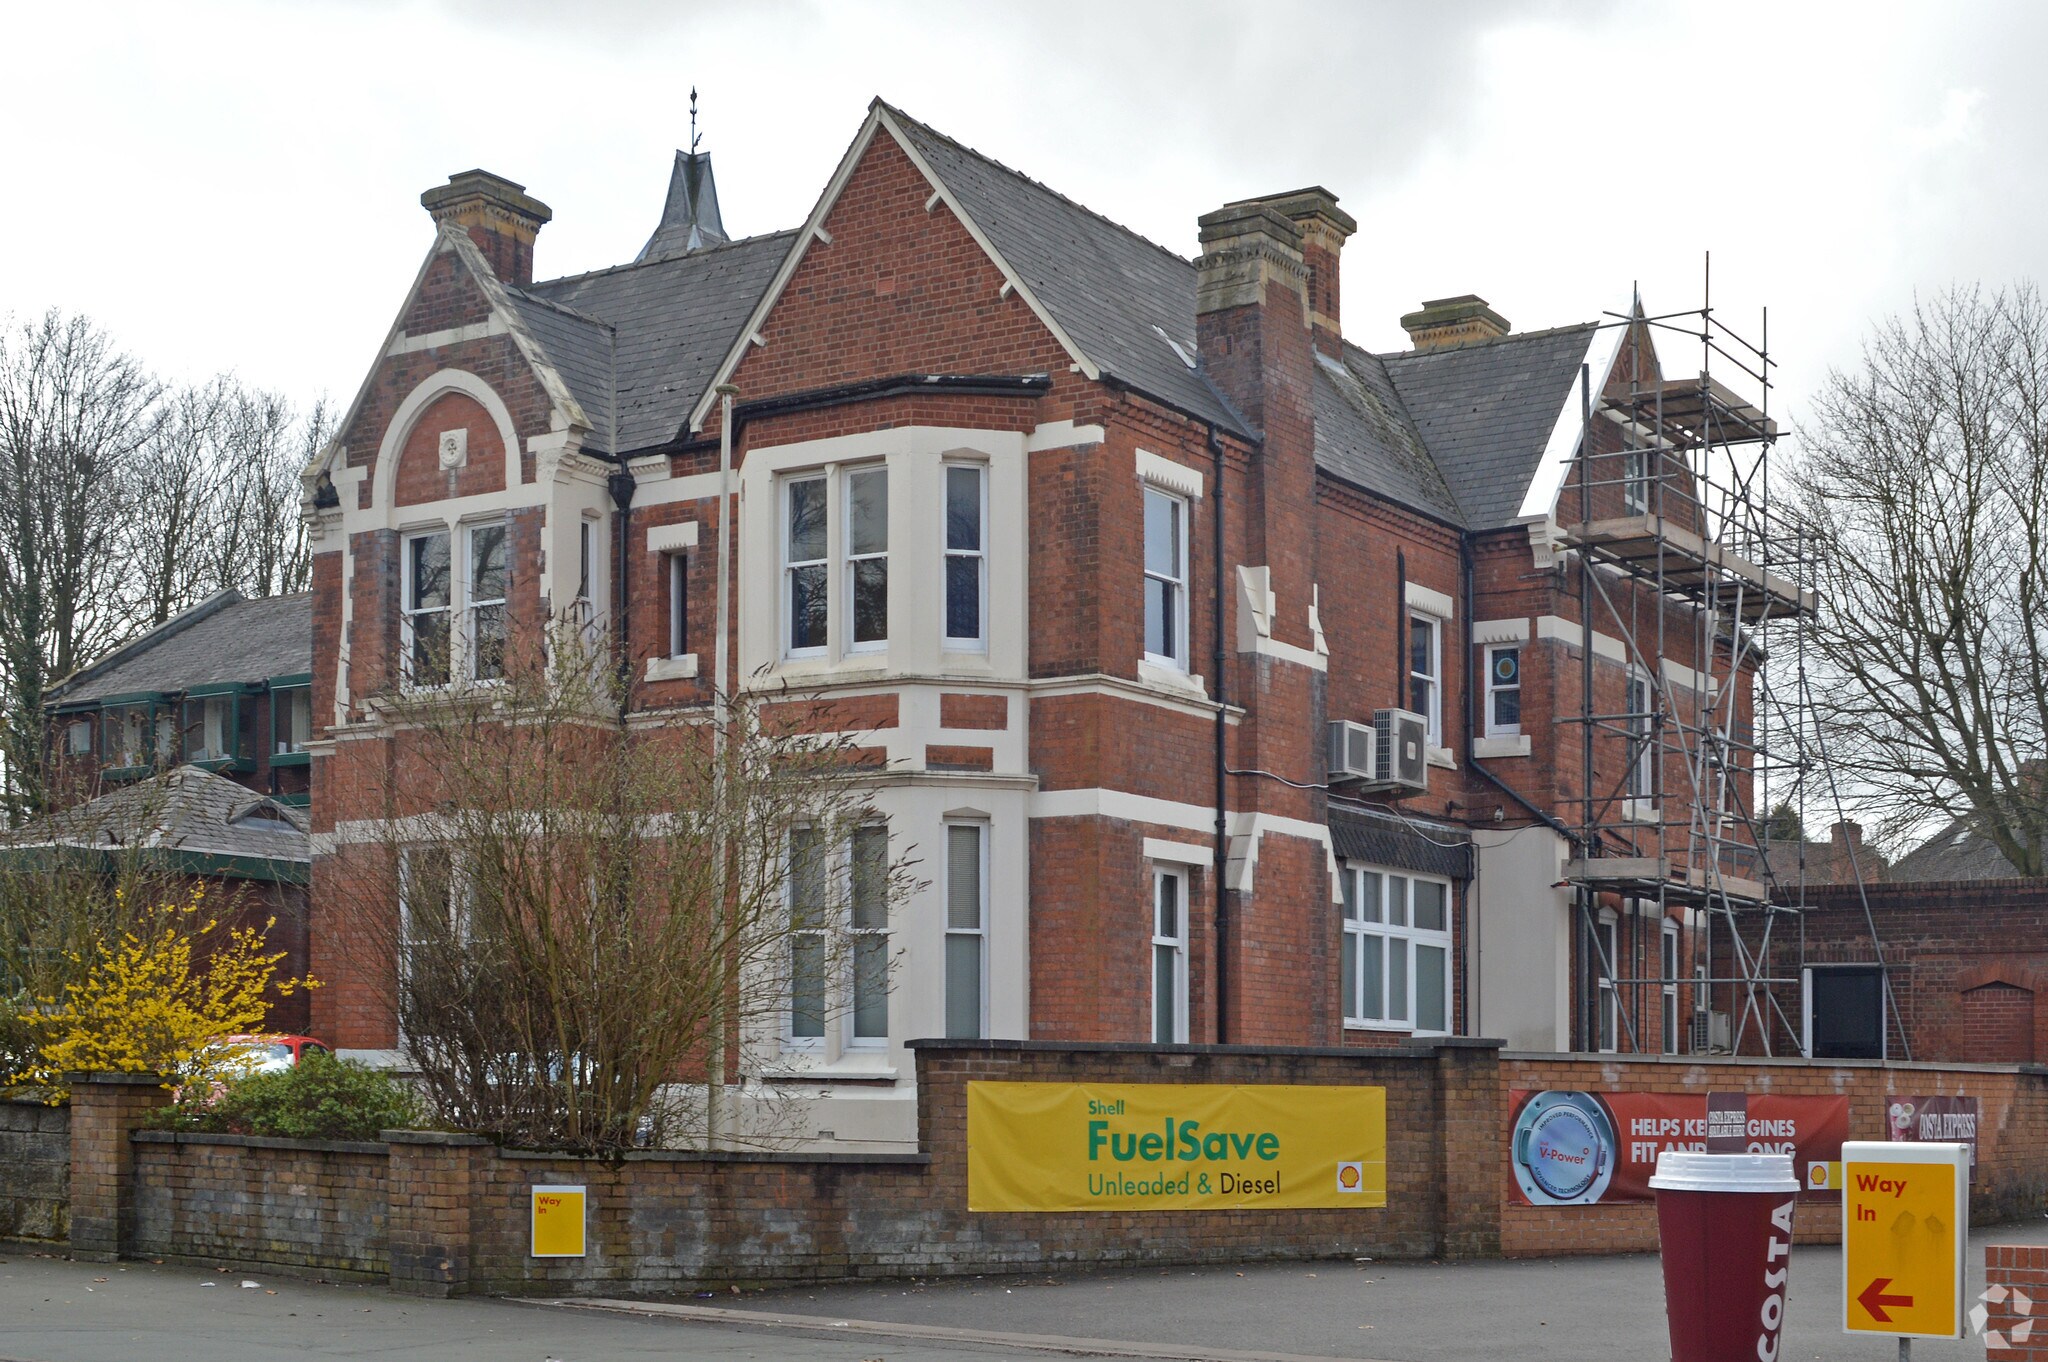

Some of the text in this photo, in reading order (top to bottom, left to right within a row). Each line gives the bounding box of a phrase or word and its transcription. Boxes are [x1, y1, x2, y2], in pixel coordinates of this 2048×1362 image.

[1088, 1099, 1125, 1115] Shell
[1631, 1118, 1680, 1137] HELPS
[1684, 1119, 1708, 1137] KE
[1943, 1113, 1976, 1139] EXPRESS
[1088, 1117, 1280, 1161] FuelSave
[1540, 1146, 1585, 1165] V-Power
[1631, 1141, 1658, 1163] FIT
[1088, 1170, 1280, 1196] Unleaded & Diesel
[1856, 1174, 1907, 1198] Way
[538, 1196, 561, 1207] Way
[538, 1206, 547, 1214] In
[1857, 1203, 1876, 1221] In
[1757, 1200, 1794, 1362] COSTA
